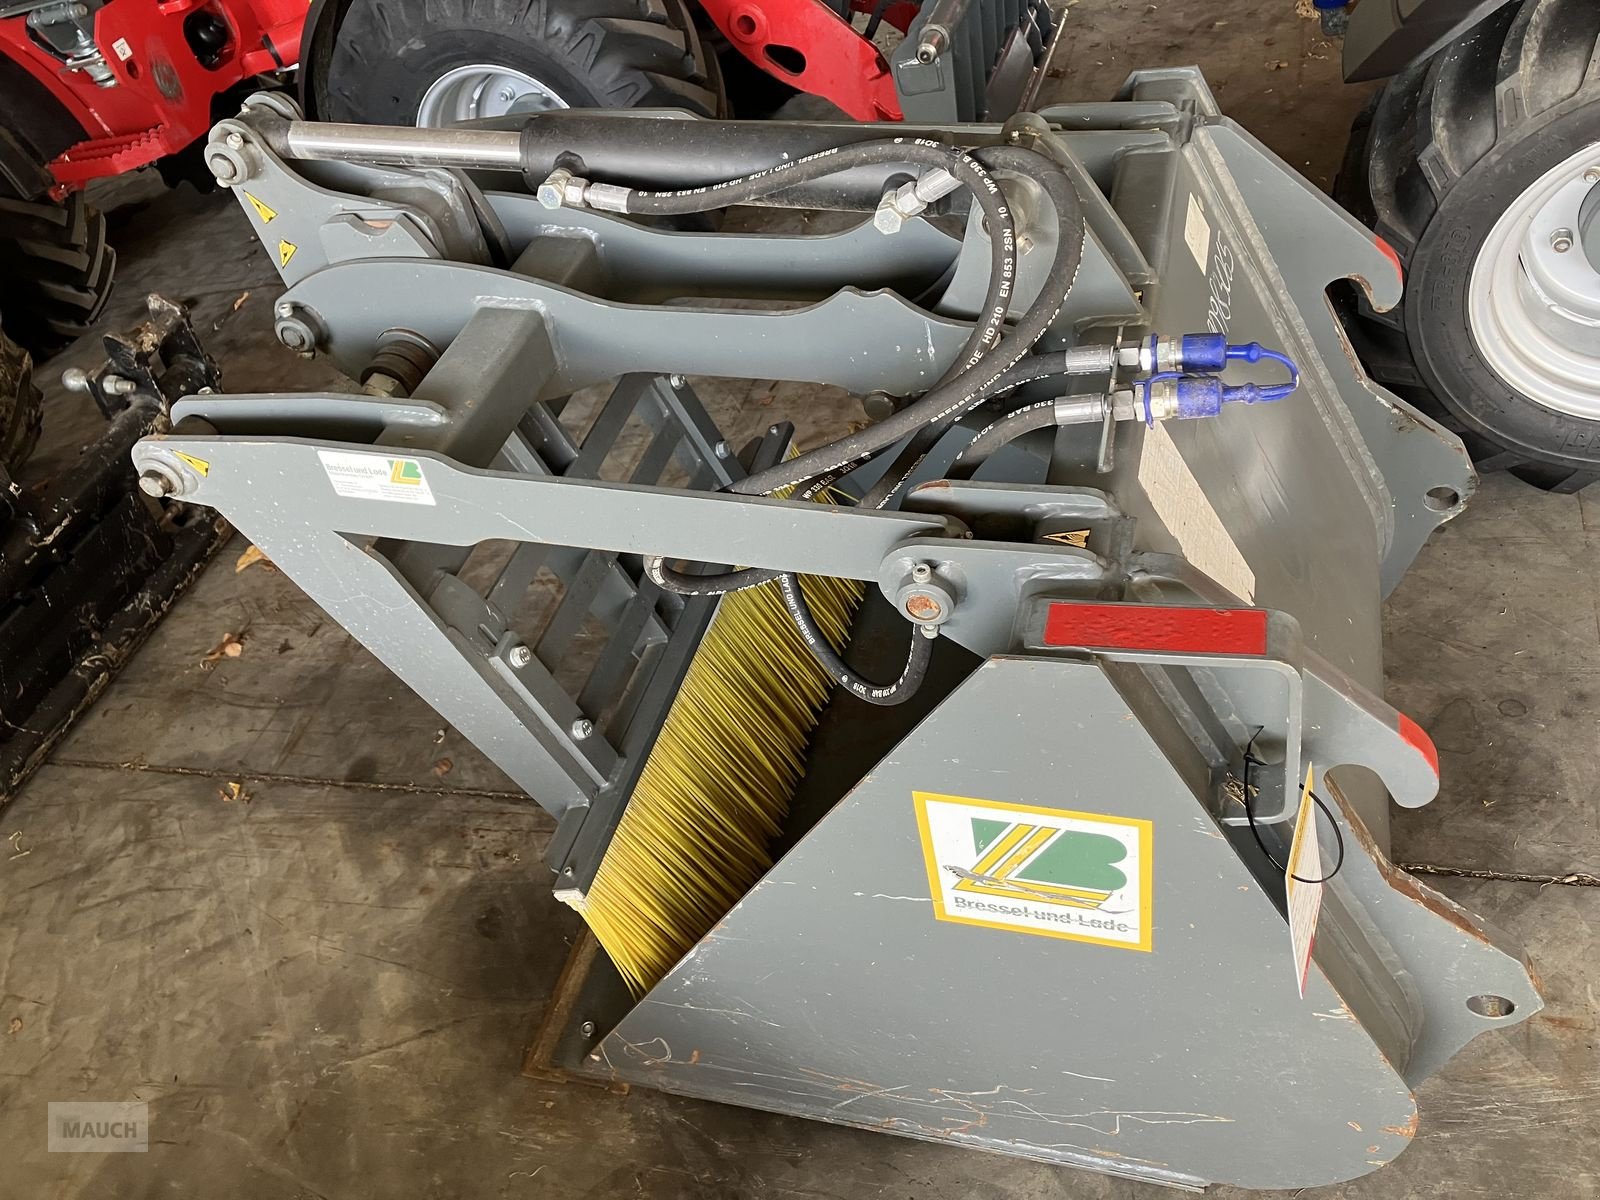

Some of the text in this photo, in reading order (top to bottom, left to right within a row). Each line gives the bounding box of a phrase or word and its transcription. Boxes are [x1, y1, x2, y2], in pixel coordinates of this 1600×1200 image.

[970, 162, 987, 177] 330
[983, 177, 998, 194] WP
[997, 206, 1009, 219] 10
[1003, 228, 1014, 251] 2SN
[1002, 257, 1013, 278] 853
[999, 281, 1011, 298] EN
[990, 306, 1004, 327] 210
[982, 327, 996, 344] HD
[961, 350, 984, 374] ADE
[1007, 406, 1031, 419] BAR
[1034, 399, 1054, 409] 330
[787, 593, 798, 609] UND
[794, 607, 815, 645] BRESSEL
[954, 896, 1029, 918] Bressel
[1034, 909, 1071, 925] und
